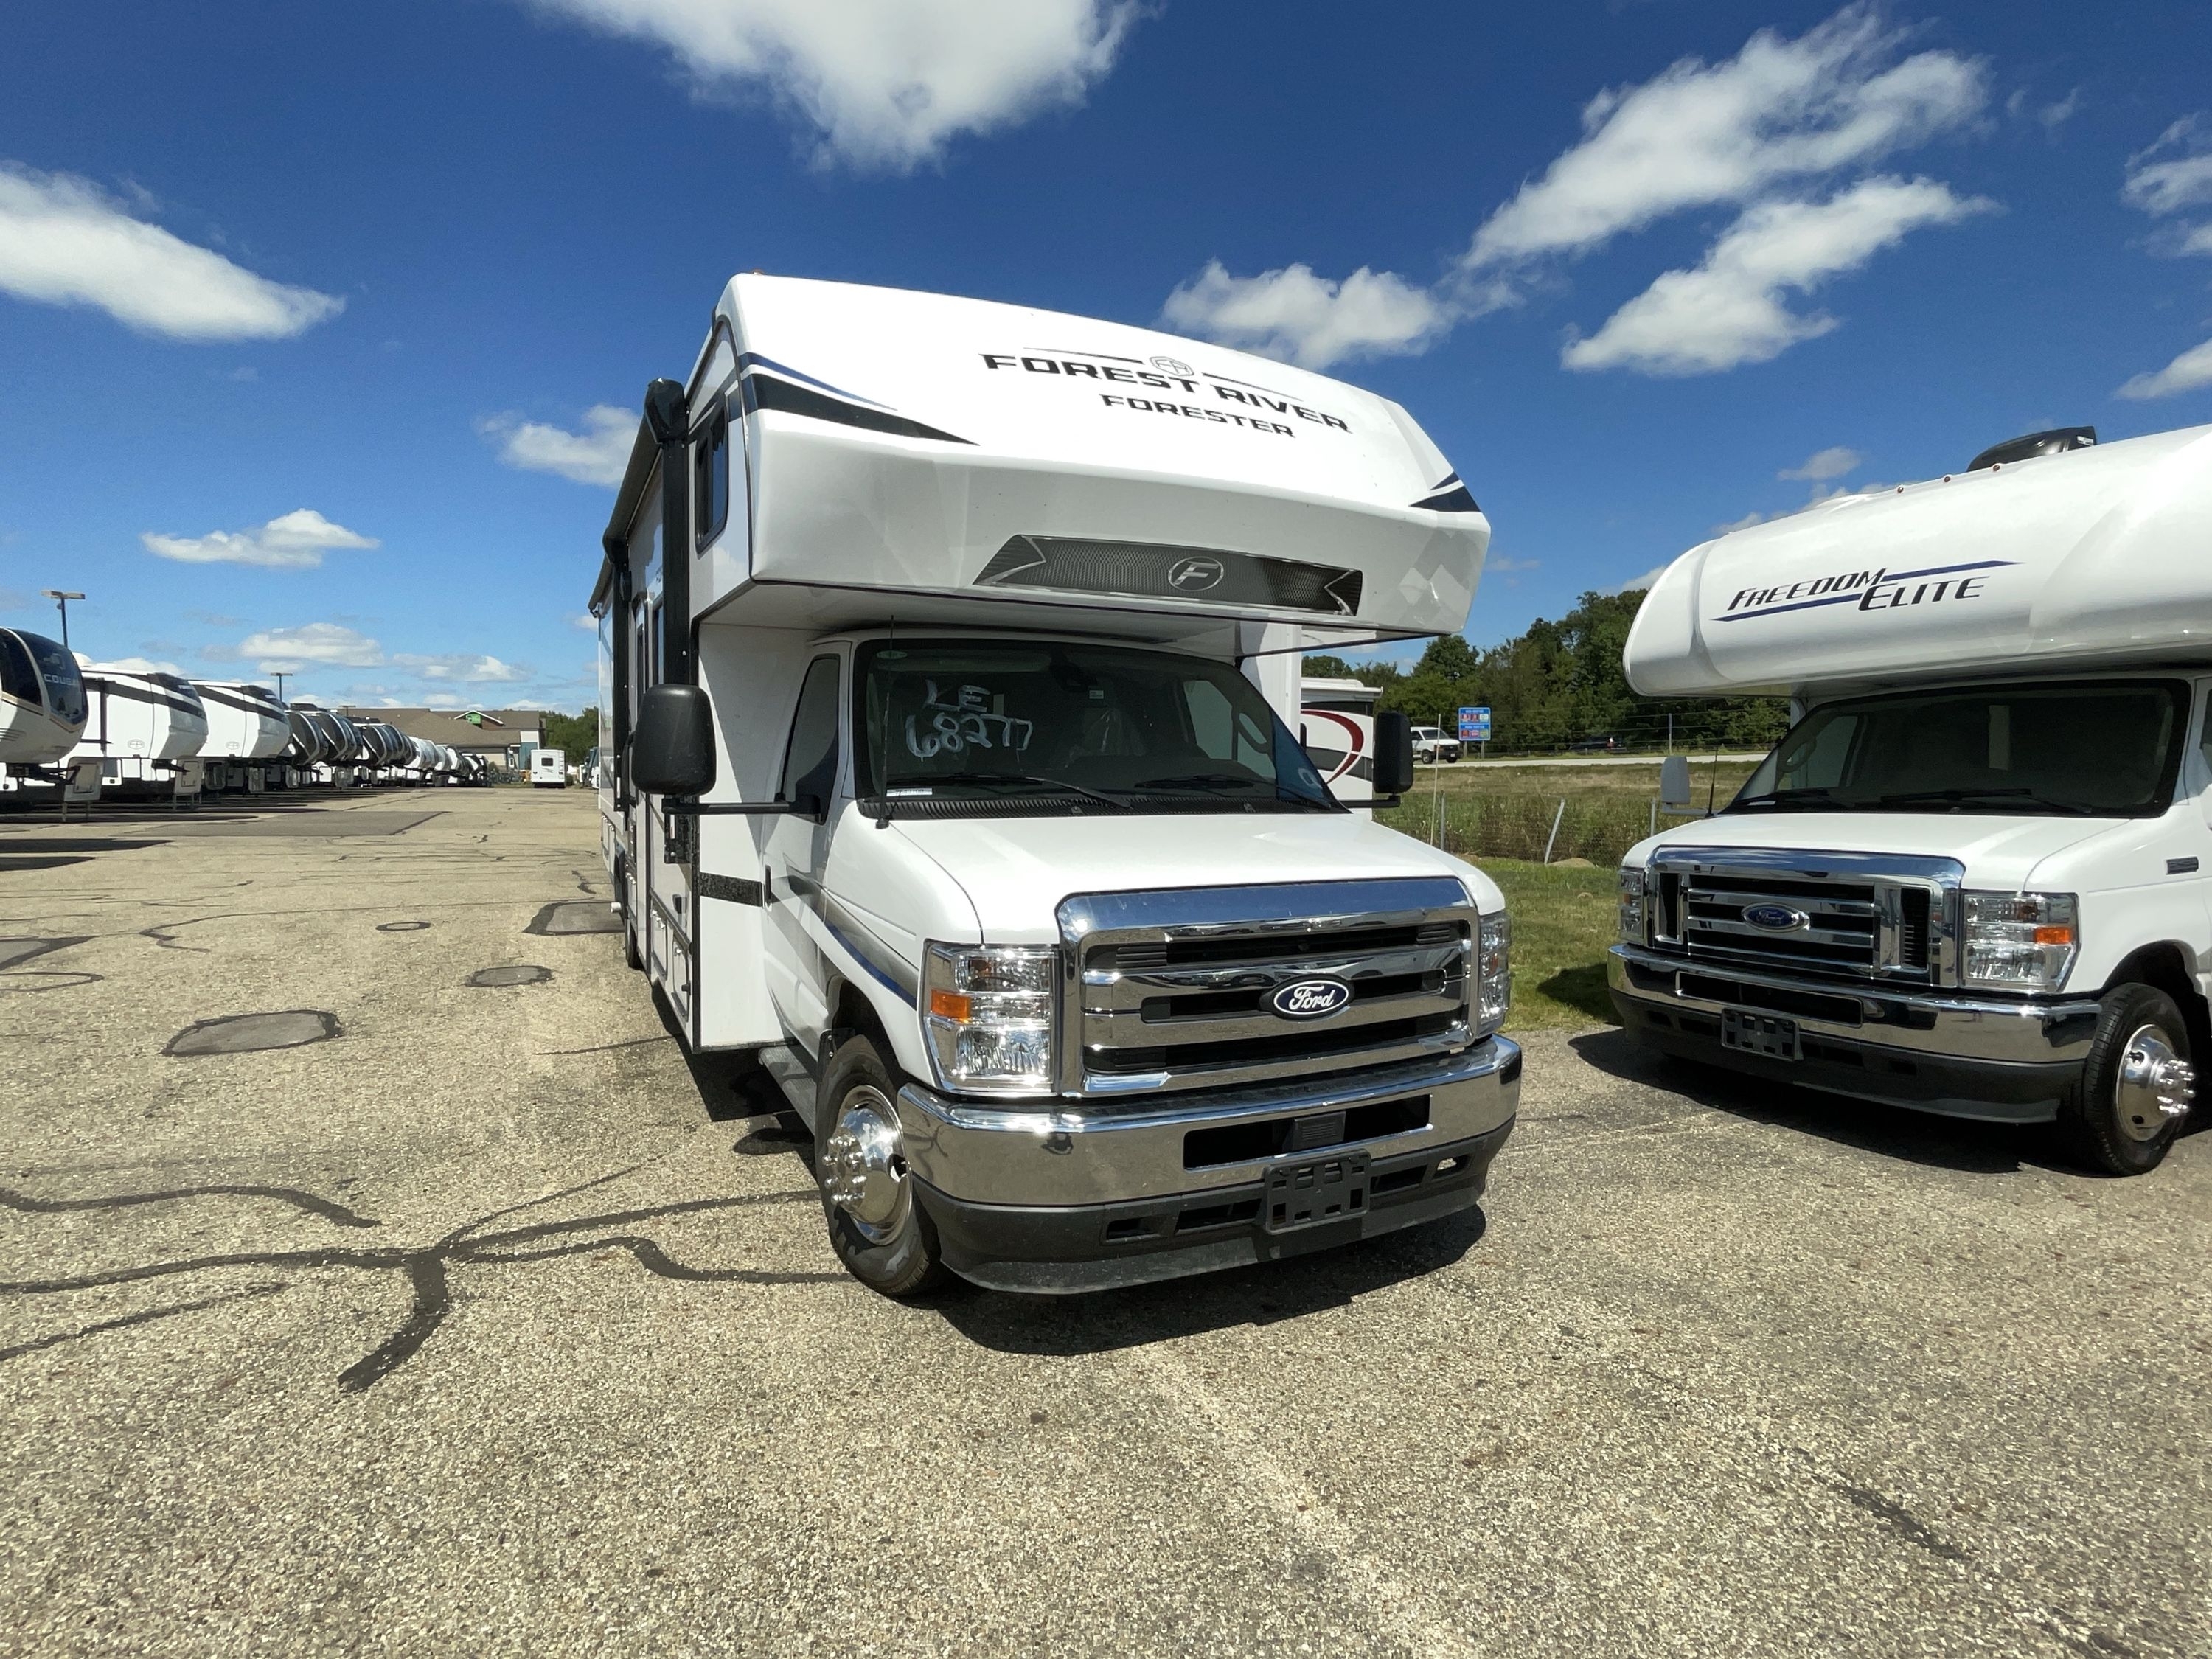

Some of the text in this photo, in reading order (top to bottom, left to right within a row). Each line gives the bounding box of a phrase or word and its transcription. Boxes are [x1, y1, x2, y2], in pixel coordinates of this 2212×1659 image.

[978, 353, 1354, 434] FOREST RIVER
[1099, 394, 1296, 439] FORESTER
[1727, 568, 1888, 611] FREEDOM
[1857, 575, 1991, 611] ELITE
[905, 712, 1033, 759] 68277
[1288, 985, 1335, 1010] Ford
